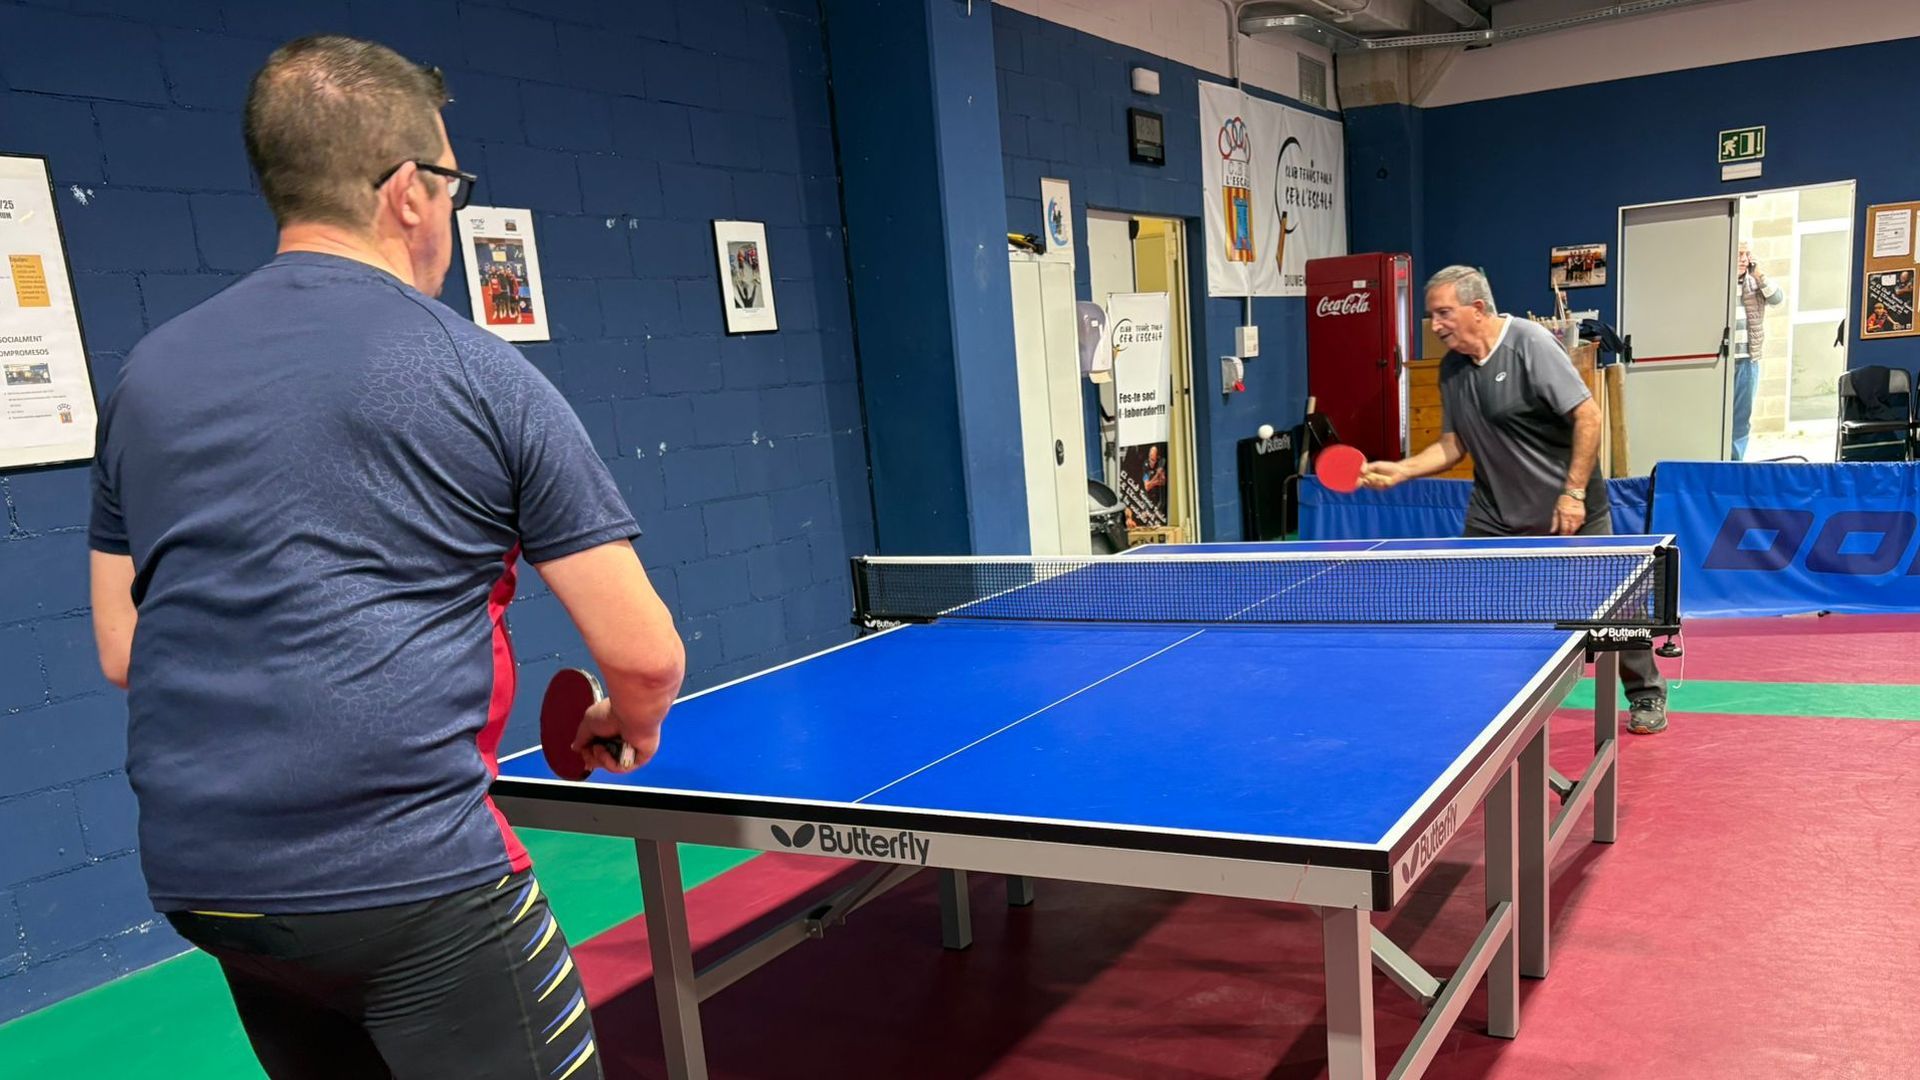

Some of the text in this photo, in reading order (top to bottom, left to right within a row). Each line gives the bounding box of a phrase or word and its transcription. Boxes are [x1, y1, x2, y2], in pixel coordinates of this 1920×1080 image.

[1285, 165, 1298, 179] CLUB
[1285, 186, 1333, 210] CER L'ESCALA
[1119, 331, 1162, 343] CER L'ESCALA
[0, 348, 49, 357] OMPROMESOS
[1119, 389, 1156, 403] Fes-te soci
[1608, 627, 1652, 639] Butterfly
[1419, 802, 1458, 868] Butterfly
[818, 824, 931, 866] Butterfly
